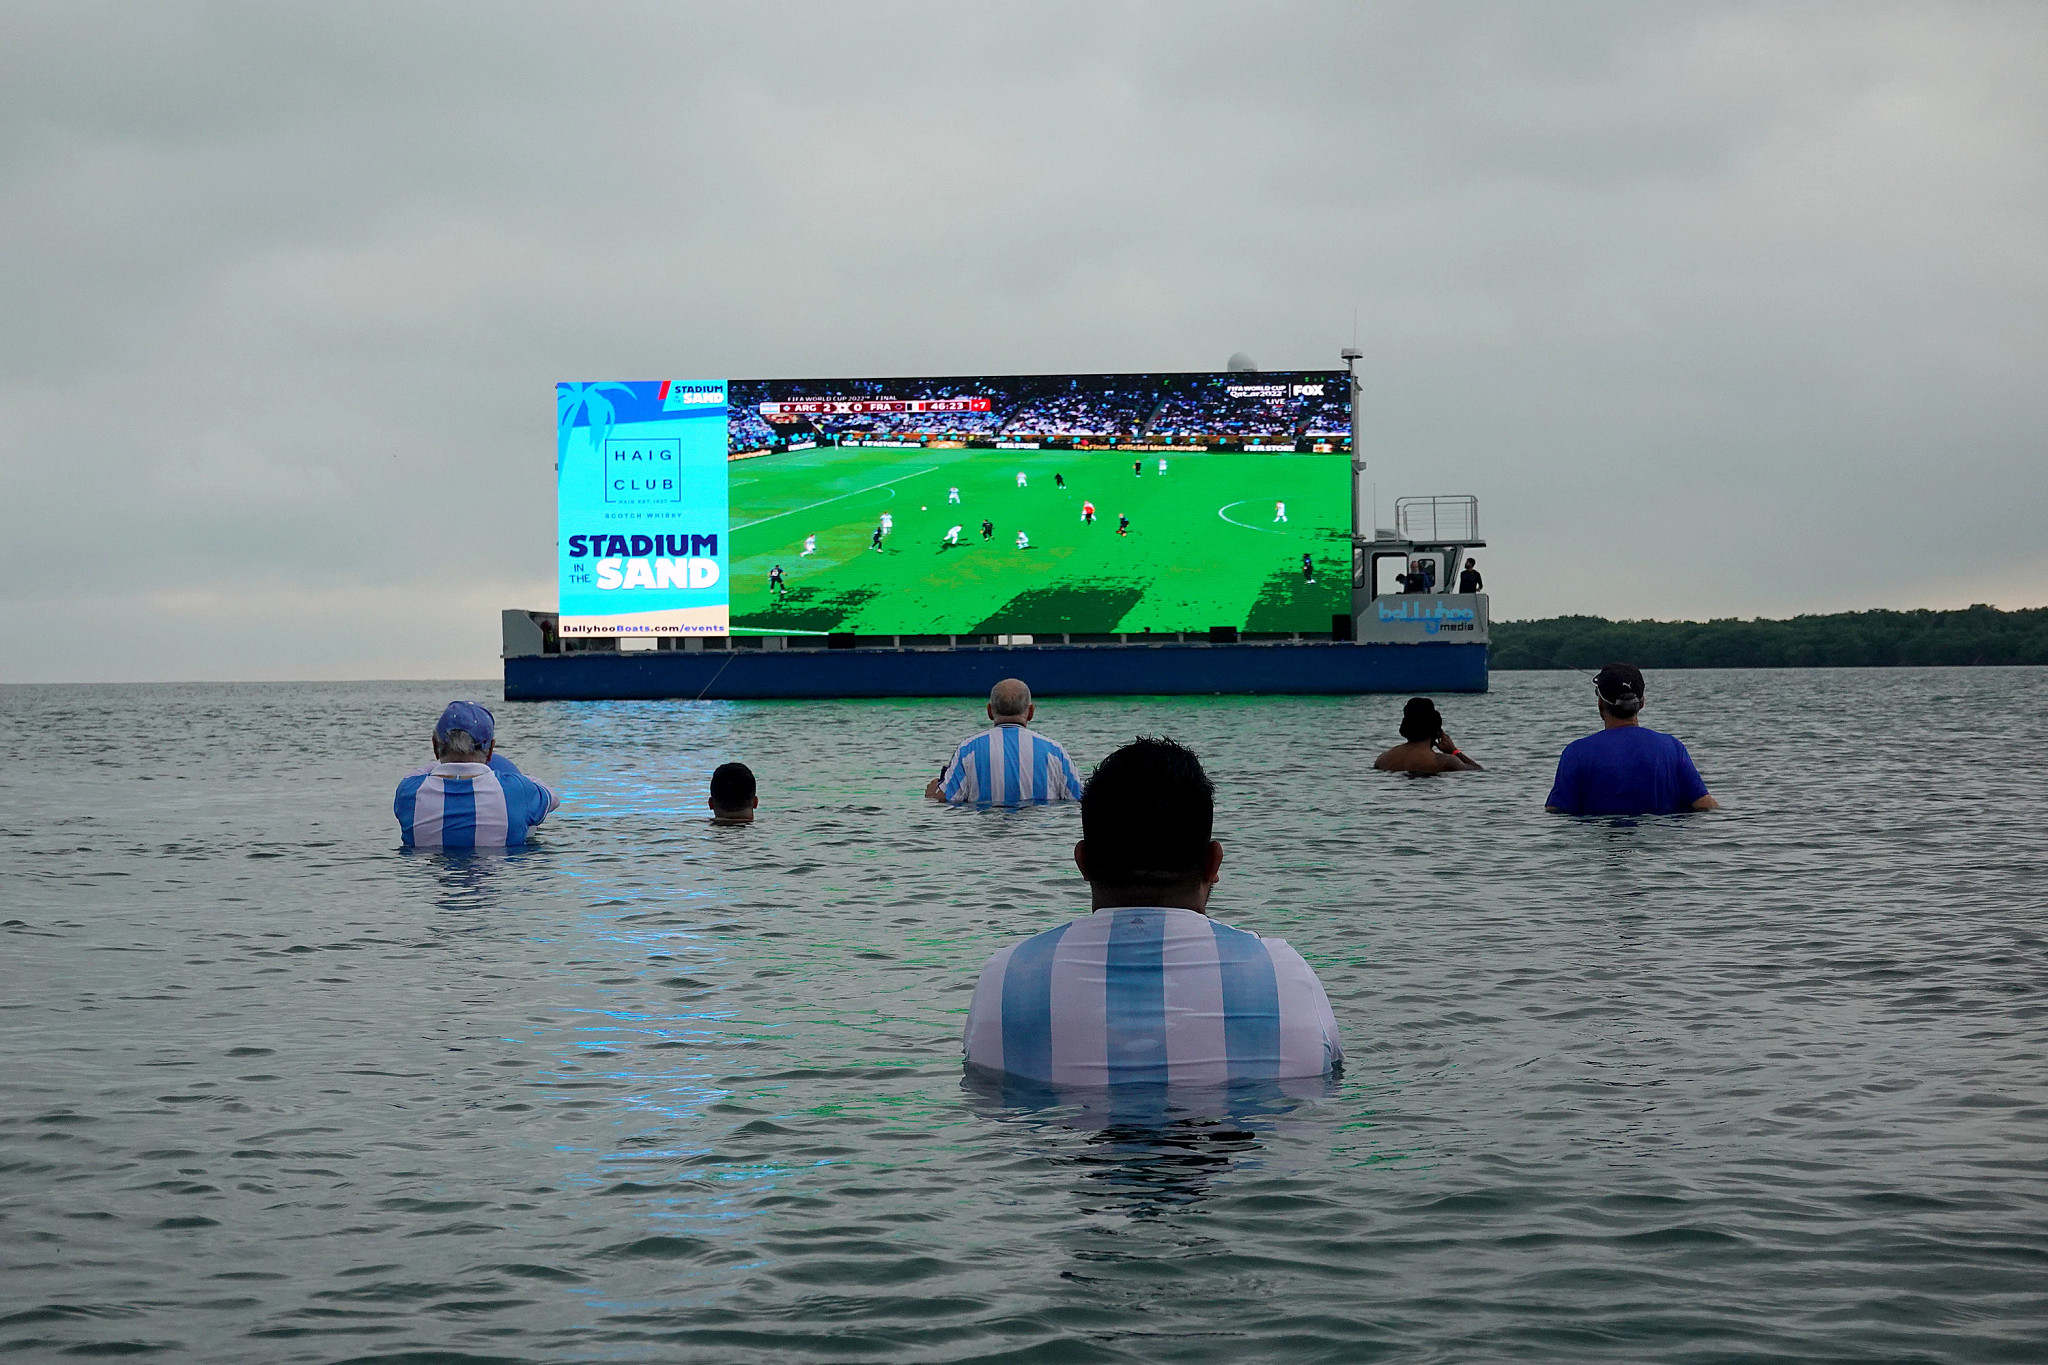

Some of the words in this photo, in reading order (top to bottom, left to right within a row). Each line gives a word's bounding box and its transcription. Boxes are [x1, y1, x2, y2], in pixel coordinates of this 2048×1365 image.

[674, 385, 723, 394] STADIUM
[1293, 384, 1324, 396] FOX
[683, 392, 725, 405] SAND
[794, 404, 817, 412] ARG
[823, 404, 831, 412] 2
[870, 403, 891, 411] FRA
[930, 402, 964, 410] 46:23
[615, 450, 672, 461] HAIG
[614, 479, 673, 490] CLUB
[568, 534, 718, 558] STADIUM
[573, 564, 584, 573] IN
[596, 557, 720, 590] SAND
[569, 574, 591, 584] THE
[563, 623, 725, 634] BallyhooBoats.com/events
[1440, 622, 1474, 631] media
